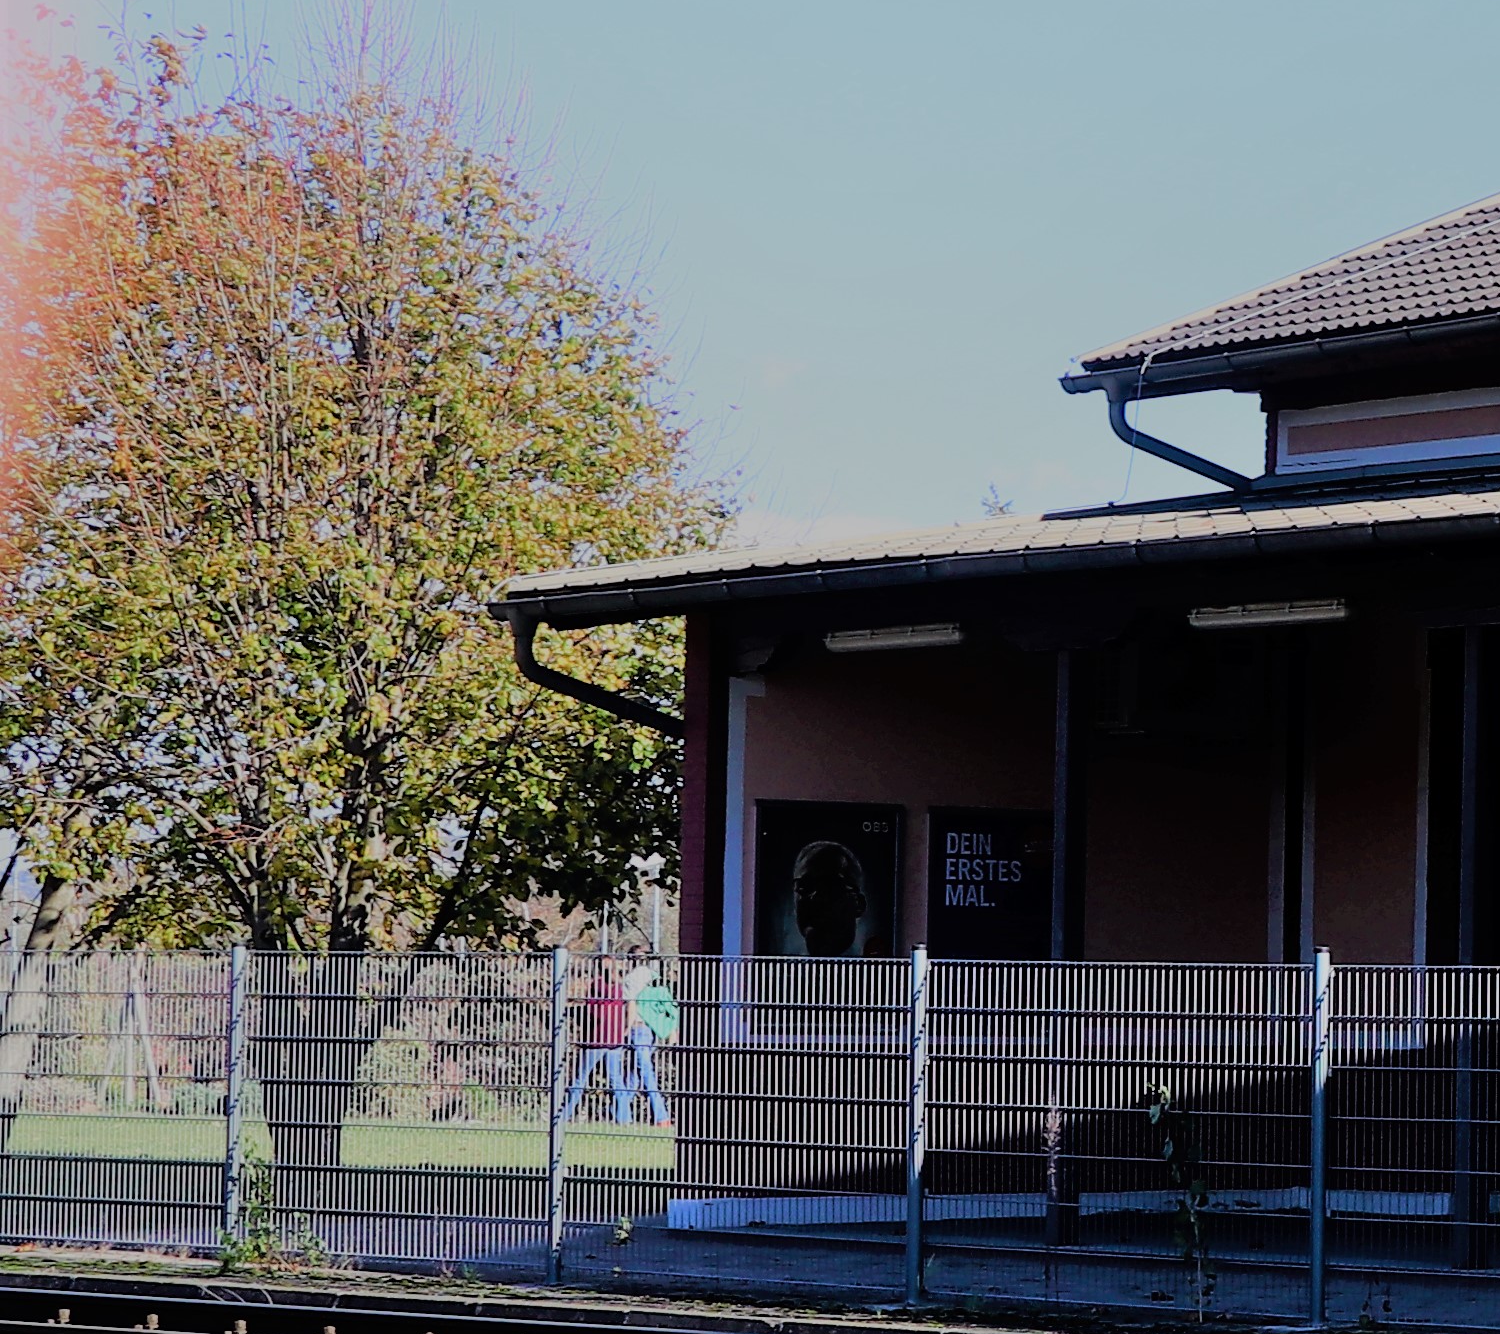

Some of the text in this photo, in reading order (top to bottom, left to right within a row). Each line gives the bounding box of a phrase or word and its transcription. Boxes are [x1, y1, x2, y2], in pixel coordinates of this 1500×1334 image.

[946, 832, 992, 855] DEIN
[945, 857, 1022, 882] ERSTES
[945, 883, 996, 908] MAL.
